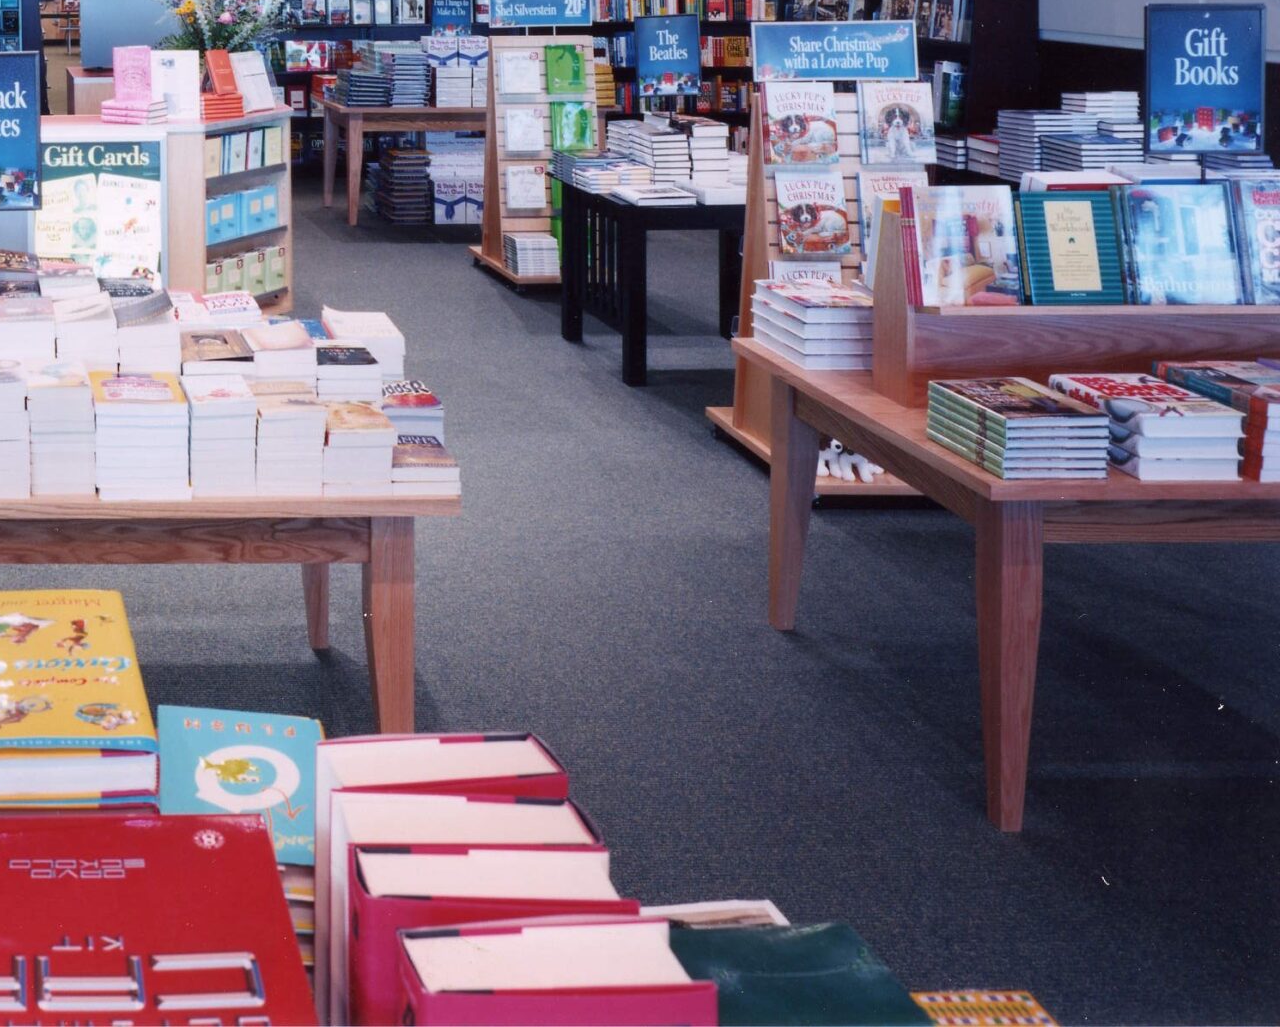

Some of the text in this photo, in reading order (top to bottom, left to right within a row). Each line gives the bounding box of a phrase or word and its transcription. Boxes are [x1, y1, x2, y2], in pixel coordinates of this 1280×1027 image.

[436, 7, 466, 16] Make Do
[495, 3, 557, 16] Shel Silverstein
[655, 30, 679, 46] The
[789, 36, 882, 54] Share Christmas
[1184, 27, 1228, 58] Gift
[649, 45, 688, 61] Beatles
[783, 53, 889, 72] with a Lovable Pup
[1174, 56, 1239, 86] Books
[774, 91, 826, 103] LUCKY PUP'S
[776, 102, 826, 113] CHRISTMAS
[43, 144, 150, 168] Gift Cards
[783, 180, 836, 191] LUCKY PUP'S
[787, 190, 836, 202] CHRISTMAS
[781, 270, 834, 282] LUCKY PUP'S
[34, 598, 102, 609] Margret
[14, 656, 132, 673] Curious
[31, 868, 126, 879] DAVID
[52, 935, 125, 952] KIT
